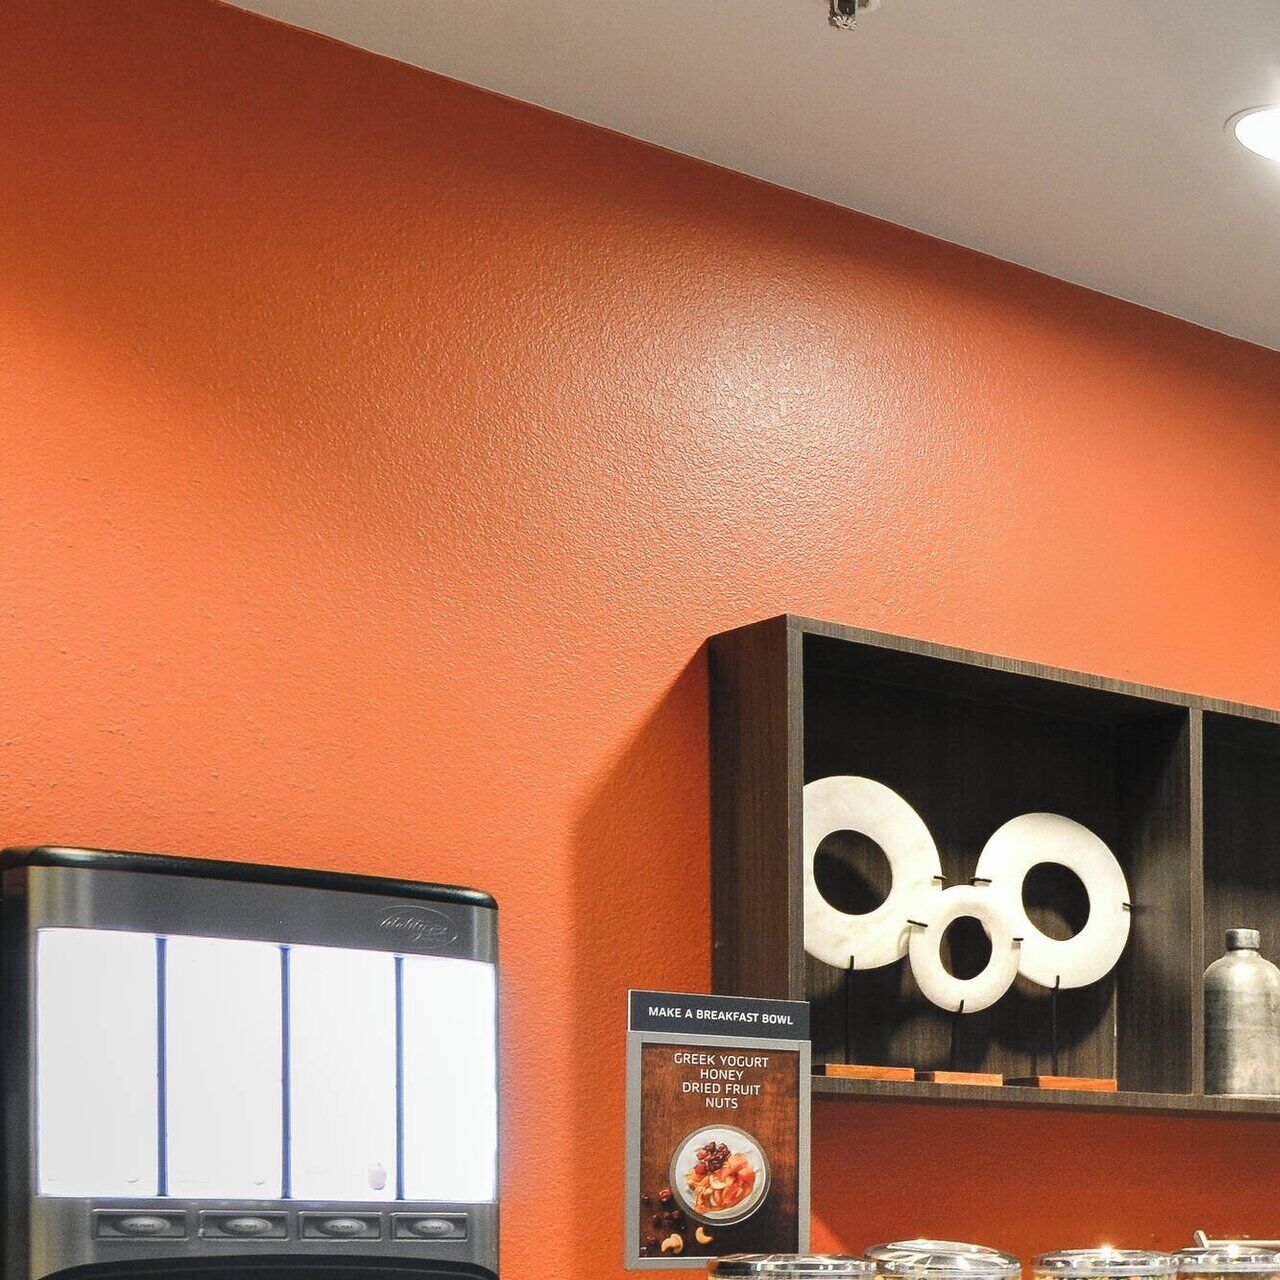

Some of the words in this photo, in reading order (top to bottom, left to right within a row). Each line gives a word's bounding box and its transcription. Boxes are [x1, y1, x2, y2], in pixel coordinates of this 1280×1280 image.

[648, 1006, 682, 1018] MAKE
[684, 1008, 693, 1019] A
[696, 1009, 760, 1023] BREAKFAST
[761, 1013, 794, 1025] BOWL
[674, 1052, 716, 1066] GREEK
[719, 1055, 769, 1068] YOGURT
[700, 1068, 744, 1081] HONEY
[682, 1081, 721, 1094] DRIED
[725, 1083, 761, 1096] FRUIT
[705, 1097, 738, 1109] NUTS
